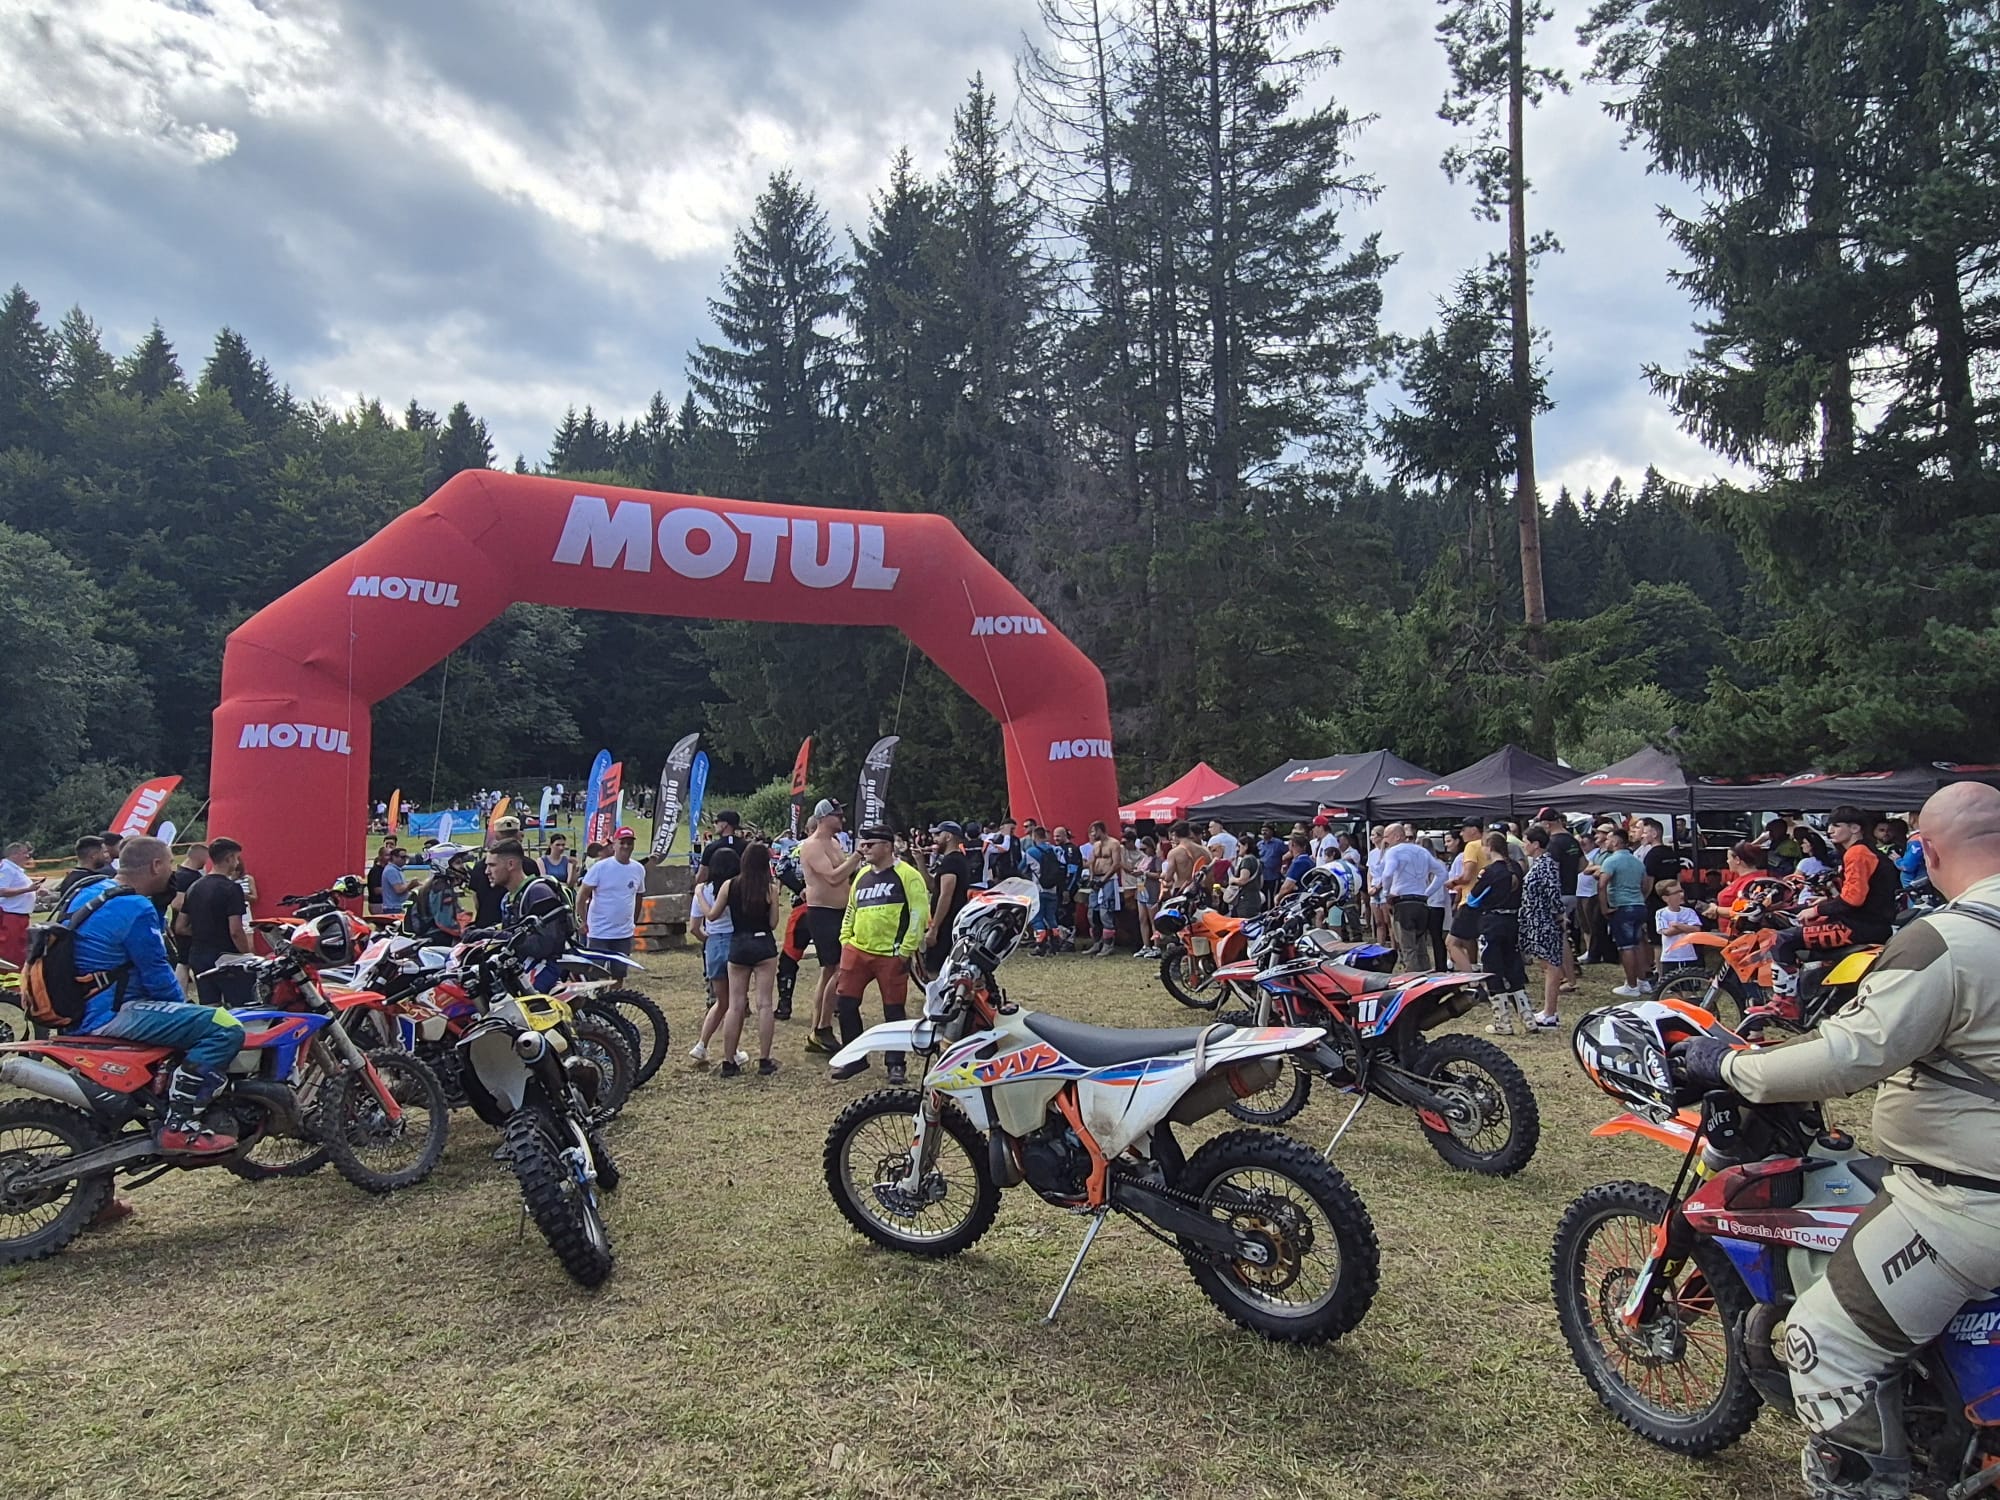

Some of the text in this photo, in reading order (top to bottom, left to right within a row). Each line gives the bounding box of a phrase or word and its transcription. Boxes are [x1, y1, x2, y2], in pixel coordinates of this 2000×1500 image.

[552, 495, 901, 591] MOTUL
[348, 575, 460, 608] MOTUL
[971, 616, 1047, 636] MOTUL
[238, 723, 352, 755] MOTUL
[663, 779, 679, 822] ENDURO
[864, 779, 877, 821] ENDURO
[1358, 999, 1378, 1023] 11
[980, 1042, 1060, 1083] DAYS
